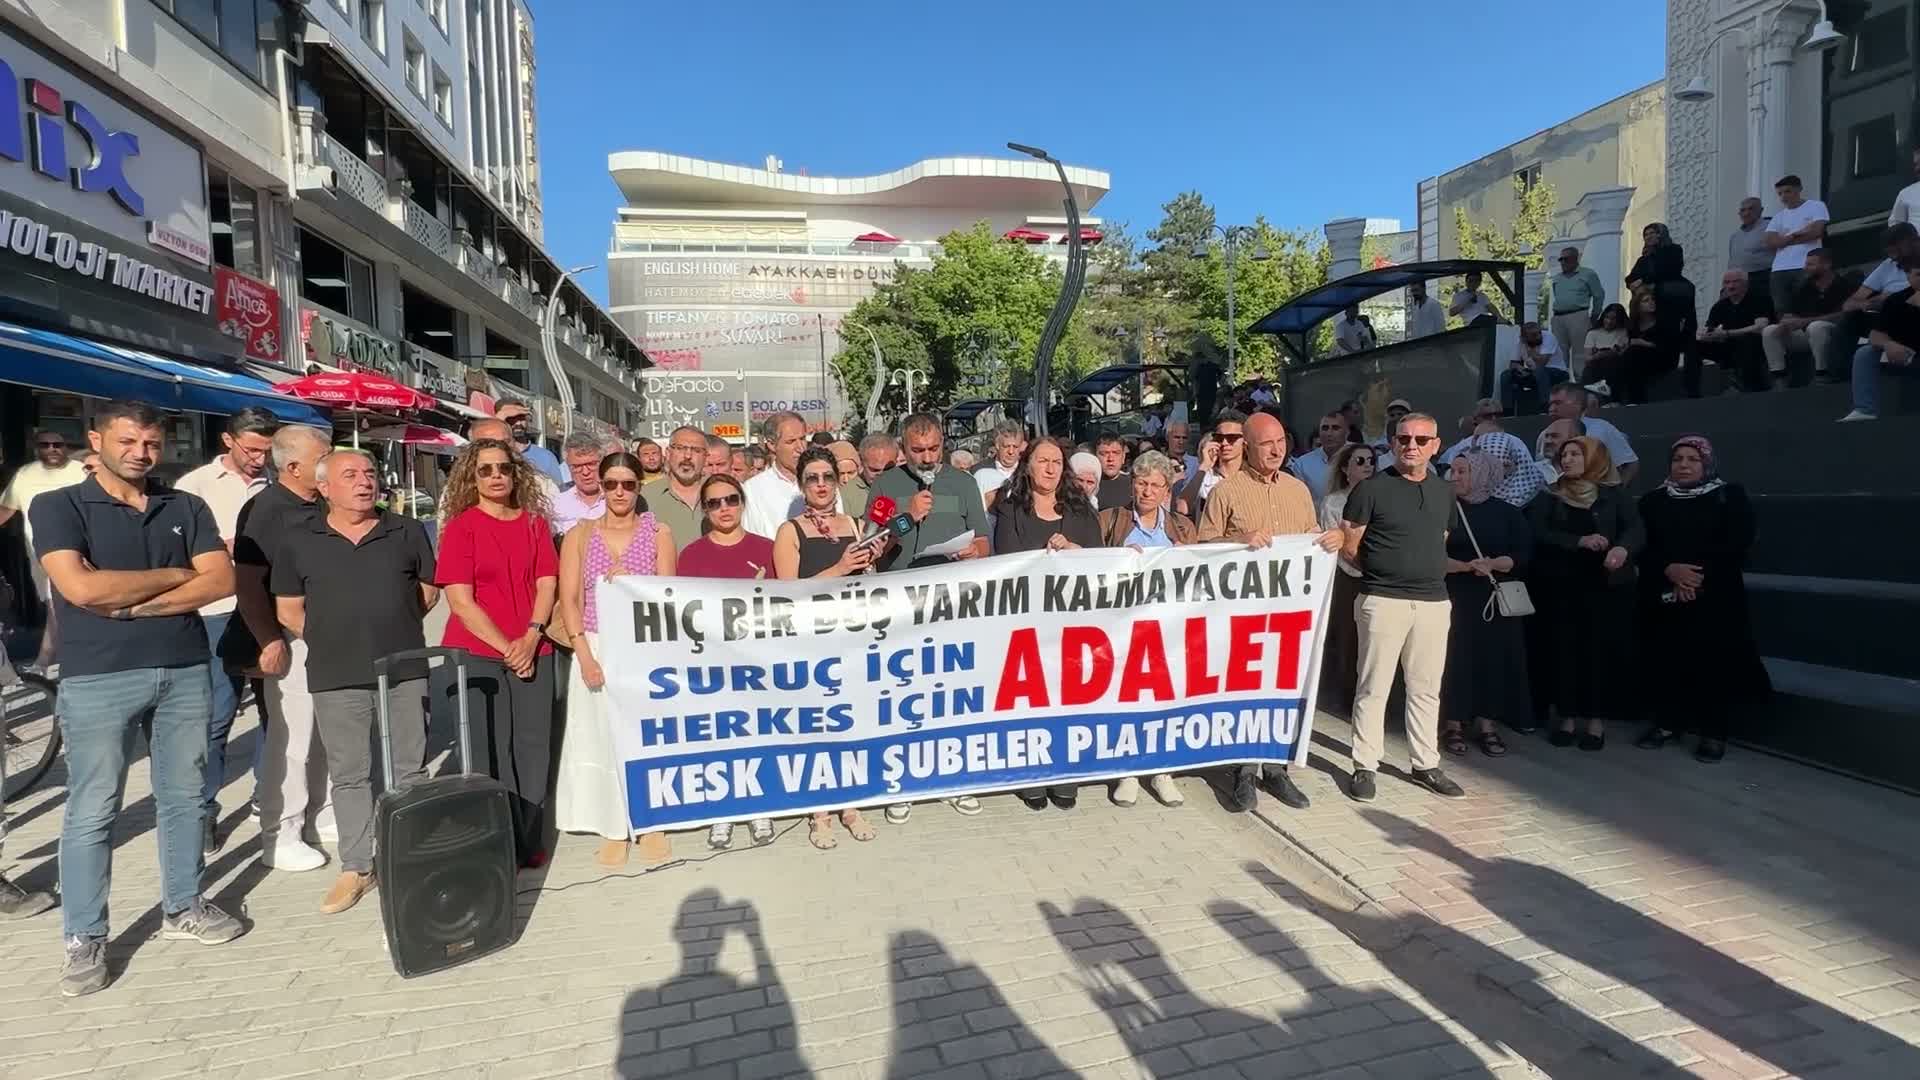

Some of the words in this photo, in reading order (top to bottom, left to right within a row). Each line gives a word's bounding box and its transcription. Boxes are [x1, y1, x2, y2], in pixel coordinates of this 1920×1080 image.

[109, 252, 215, 315] MARKET
[644, 262, 697, 276] ENGLISH
[704, 262, 741, 276] HOME
[747, 265, 846, 280] AYAKKABI
[645, 311, 711, 323] TIFFANY
[734, 311, 800, 326] TOMATO
[648, 377, 725, 394] DeFacto
[751, 400, 788, 412] POLO
[633, 587, 705, 654] HİÇ
[721, 586, 798, 642] BİR
[811, 581, 892, 640] DÜŞ
[903, 575, 1030, 626] YARIM
[1042, 558, 1292, 613] KALMAYACAK
[648, 656, 843, 697] SURUÇ
[866, 637, 976, 688] İÇİN
[993, 609, 1313, 713] ADALET
[640, 703, 855, 748] HERKES
[877, 682, 985, 730] İÇİN
[647, 757, 764, 809] KESK
[775, 749, 869, 794] VAN
[882, 727, 1054, 794] ŞUBELER
[1066, 708, 1300, 763] PLATFORMU
